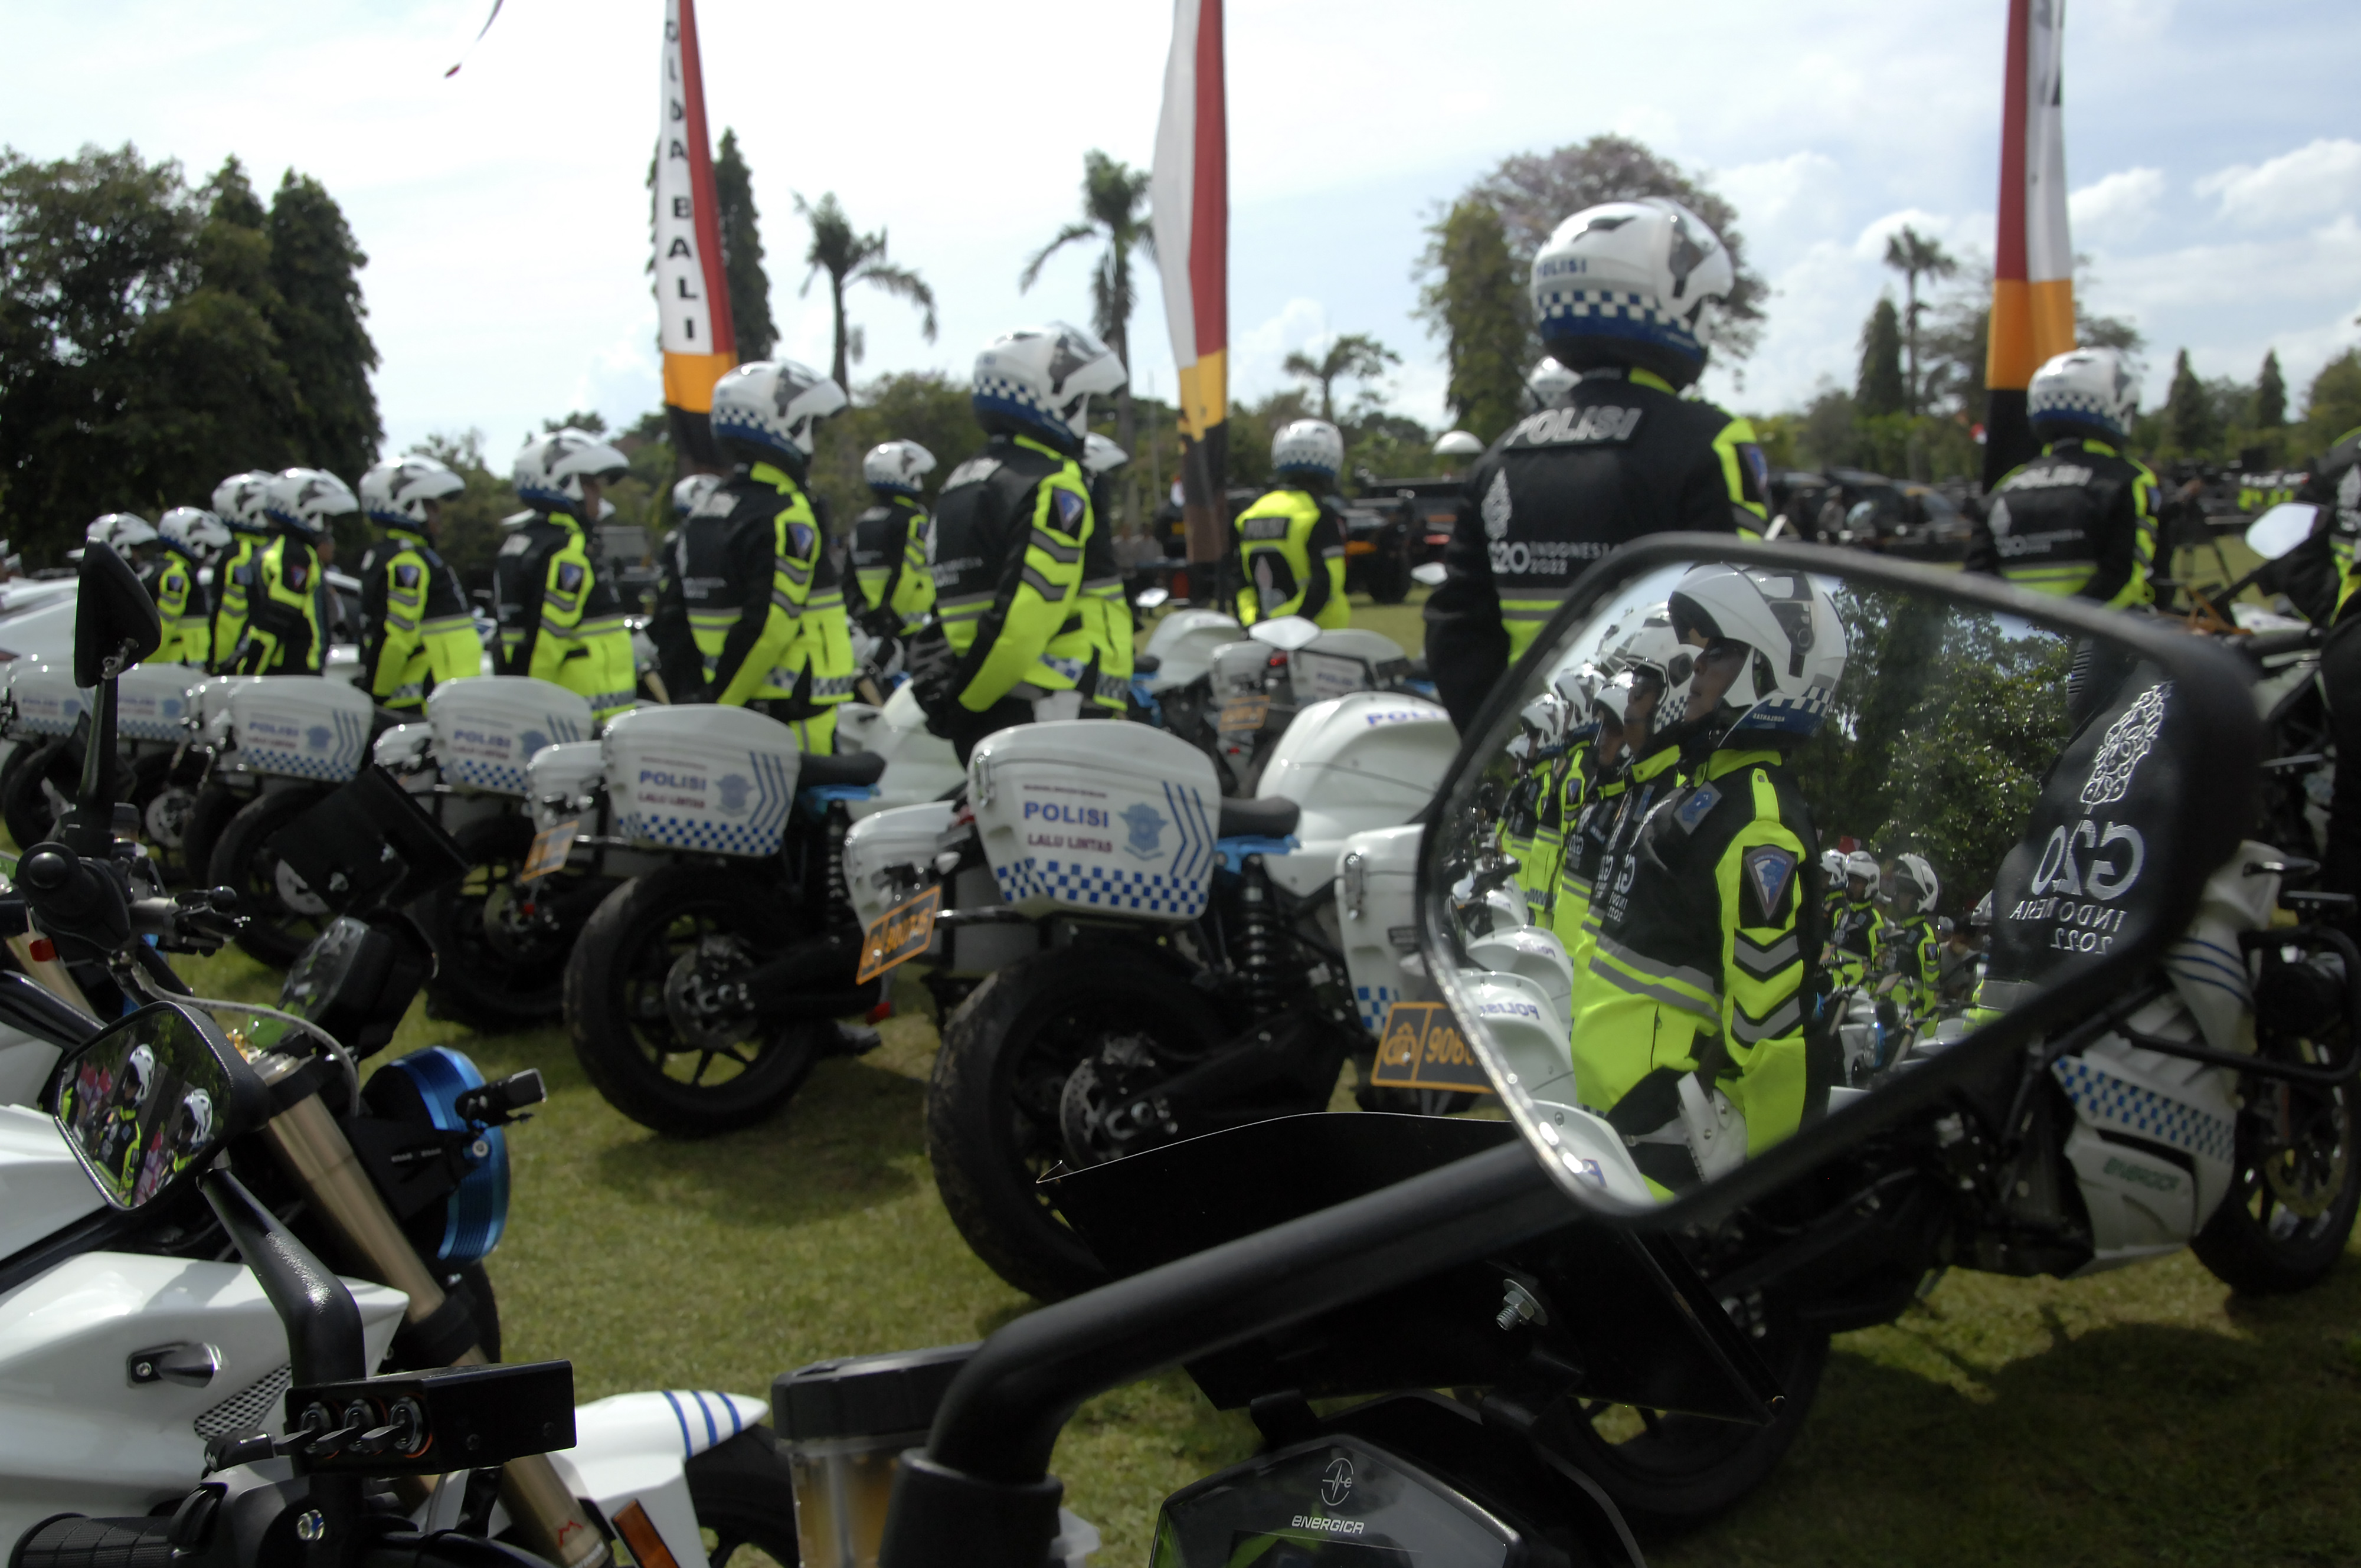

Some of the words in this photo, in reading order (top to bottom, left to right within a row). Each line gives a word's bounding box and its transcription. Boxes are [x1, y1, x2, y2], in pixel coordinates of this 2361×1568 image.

[668, 197, 698, 341] BALI
[640, 770, 707, 791] POLISI
[1024, 801, 1108, 828] POLISI
[1028, 833, 1064, 848] LALU
[1067, 836, 1113, 853] LINTAS
